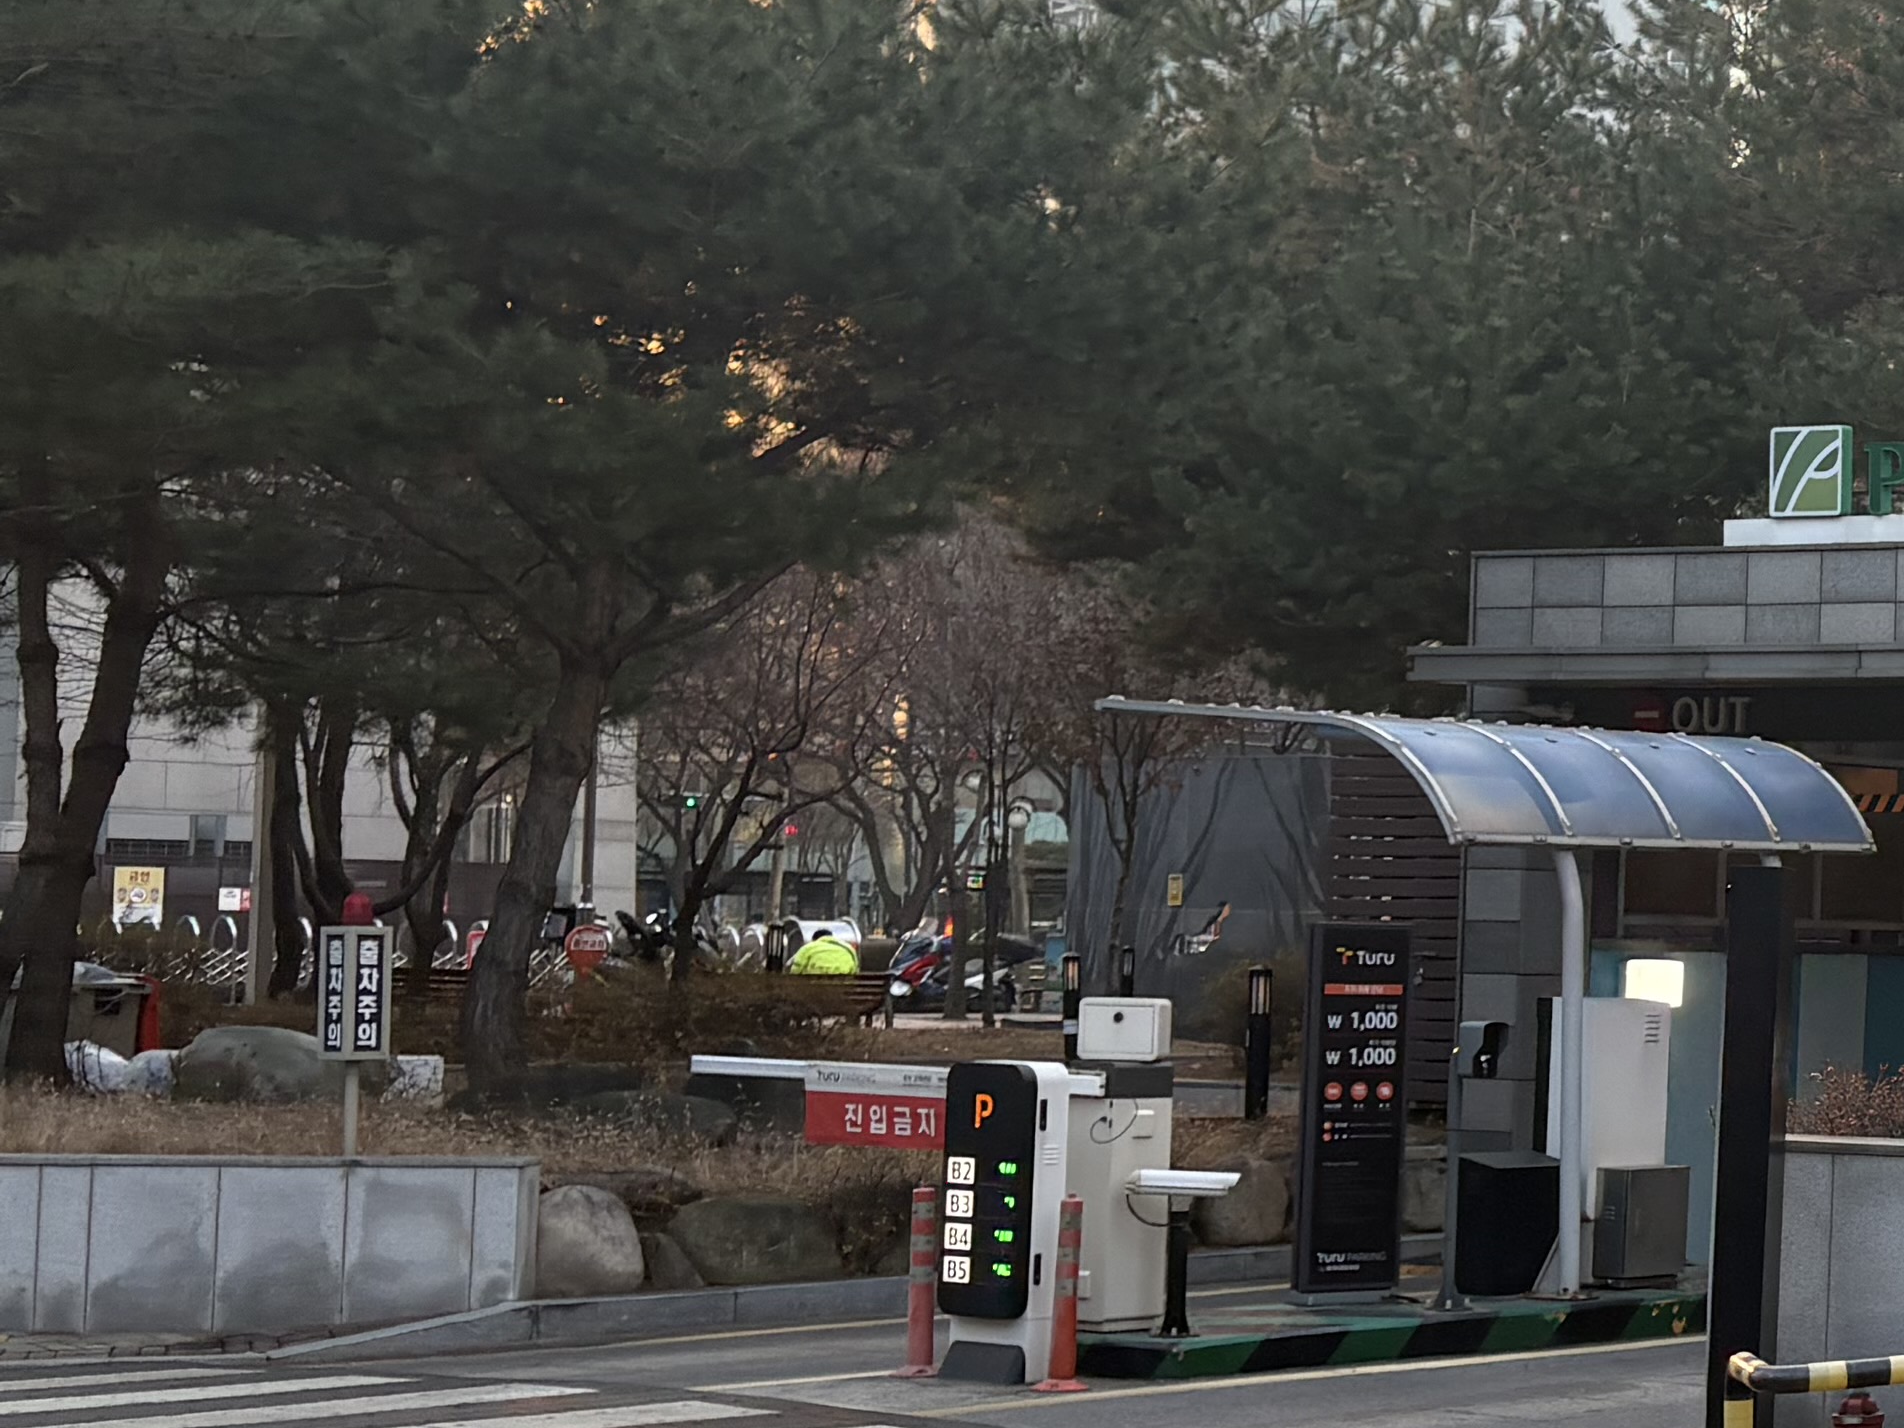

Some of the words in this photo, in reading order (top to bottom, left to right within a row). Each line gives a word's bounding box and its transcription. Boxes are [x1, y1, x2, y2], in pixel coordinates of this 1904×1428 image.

[1672, 696, 1751, 734] OUT
[1350, 1011, 1398, 1032] 1,000
[1348, 1047, 1397, 1066] 1,000
[844, 1103, 936, 1137] 진입금지
[974, 1093, 994, 1129] P
[951, 1160, 972, 1181] B2
[949, 1193, 970, 1214] B3
[948, 1227, 968, 1247] B4
[947, 1260, 967, 1280] B5
